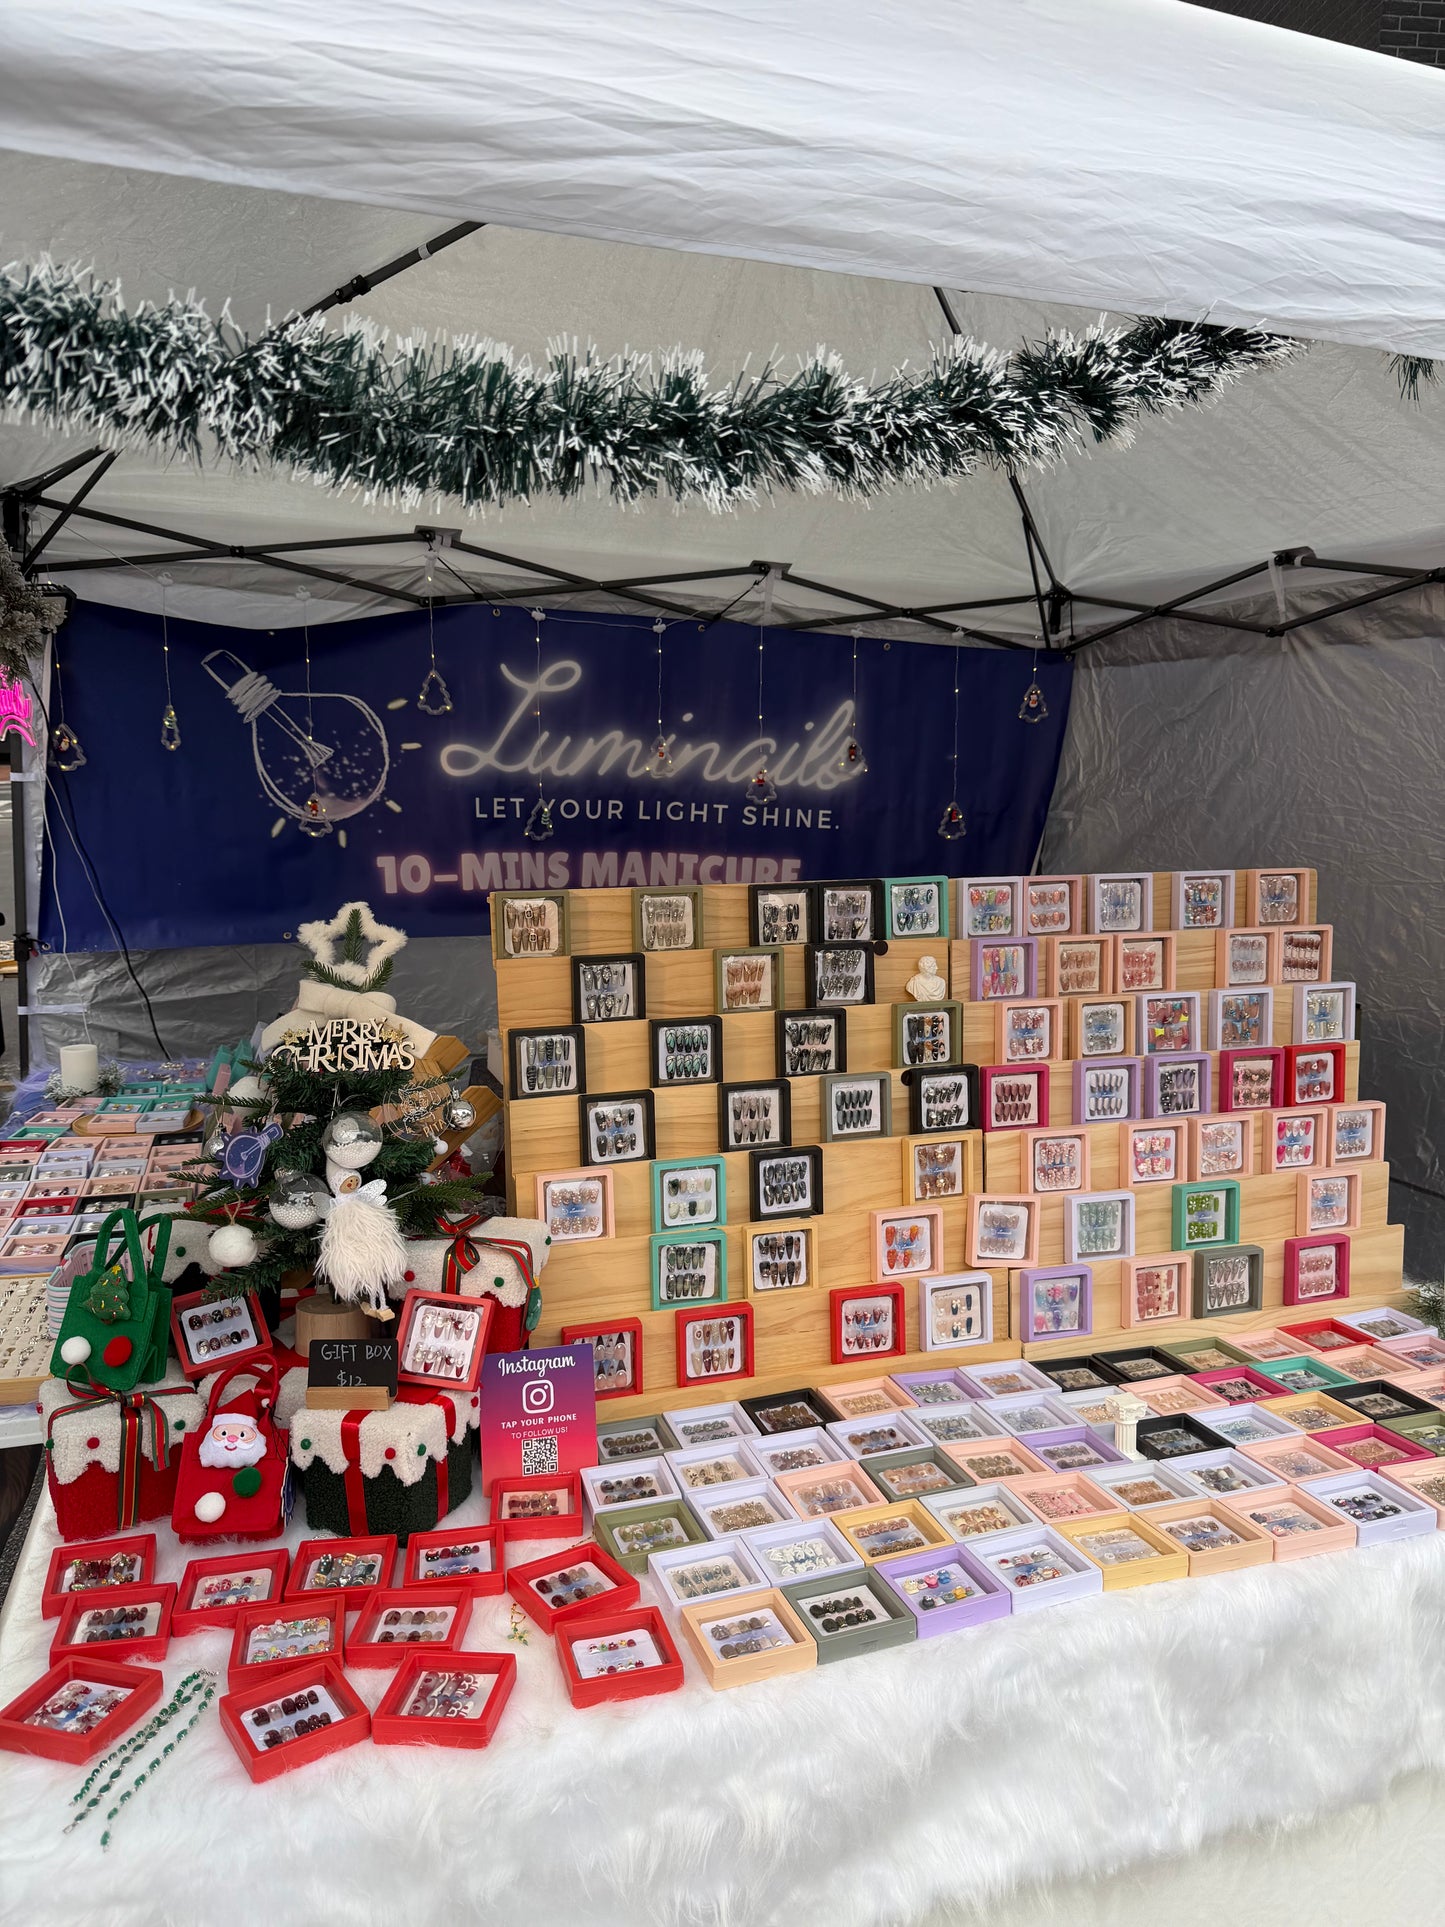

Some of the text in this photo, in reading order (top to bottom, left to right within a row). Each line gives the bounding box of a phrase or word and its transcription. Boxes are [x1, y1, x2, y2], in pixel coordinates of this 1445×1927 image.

[440, 660, 864, 790] Luminails
[475, 797, 525, 819] LET
[638, 800, 729, 824] LIGHT
[742, 805, 840, 830] SHINE.
[376, 851, 801, 895] 10-MINS MANICURE
[307, 1016, 388, 1046] MERRY
[271, 1039, 416, 1073] CHRISTMAS
[321, 1343, 392, 1362] GIFT BOX
[336, 1369, 367, 1387] $12
[498, 1355, 576, 1377] Instagram
[501, 1413, 577, 1430] TAP YOUR PHONE
[522, 1428, 555, 1438] FOLLOW
[555, 1426, 568, 1435] US!
